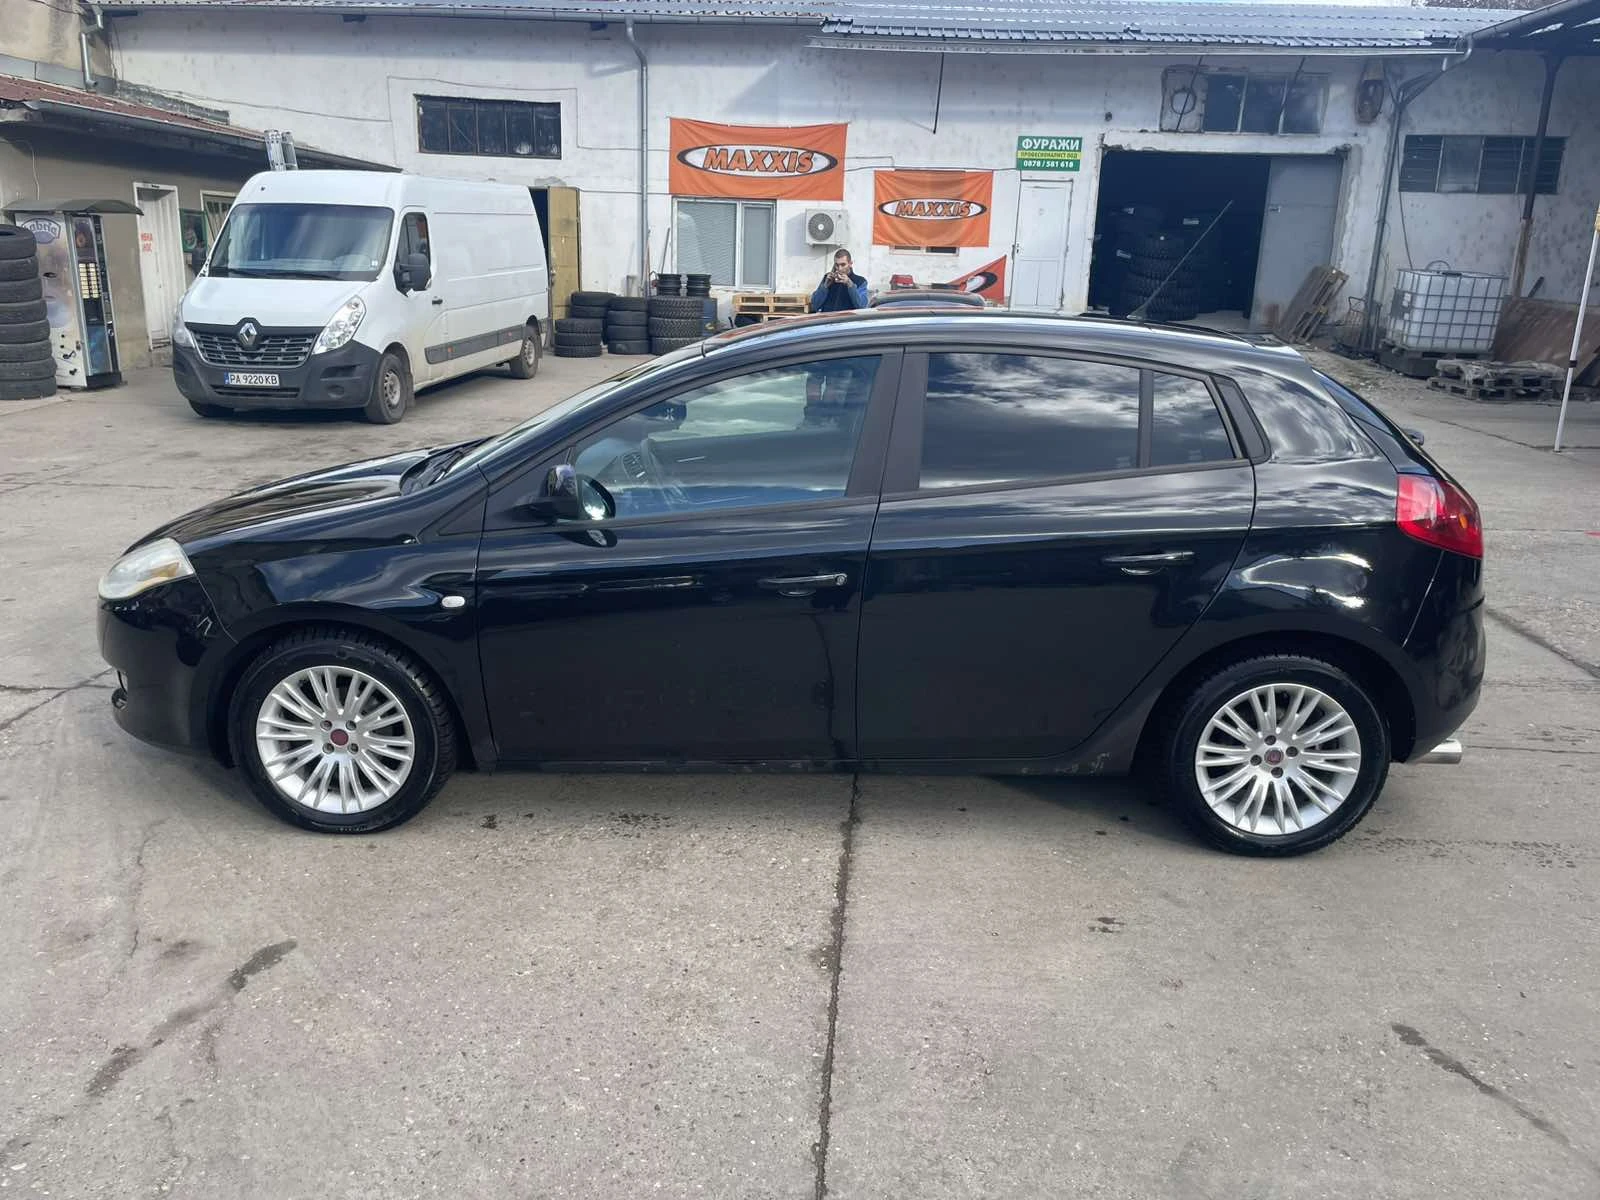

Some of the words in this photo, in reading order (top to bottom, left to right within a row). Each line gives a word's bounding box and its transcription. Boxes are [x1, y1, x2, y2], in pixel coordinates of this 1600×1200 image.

[1022, 138, 1079, 150] ФУРАЖИ
[703, 148, 814, 173] MAXXIS
[895, 200, 971, 218] MAXXIS
[230, 374, 241, 384] PA
[242, 374, 264, 385] 9220
[264, 376, 278, 384] KB
